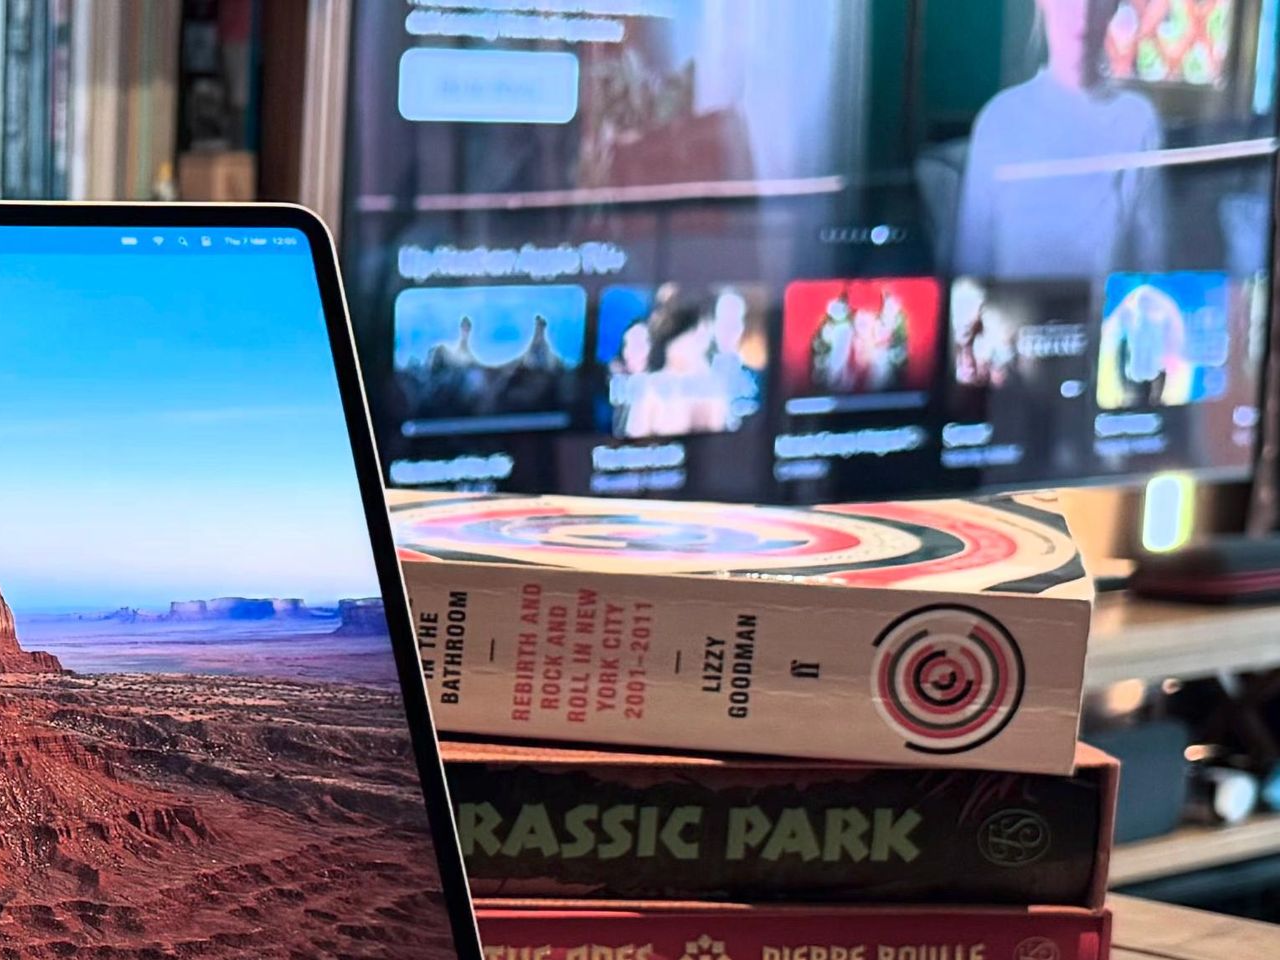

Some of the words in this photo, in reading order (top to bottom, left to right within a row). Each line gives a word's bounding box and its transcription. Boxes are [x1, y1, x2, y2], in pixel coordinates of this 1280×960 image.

[521, 583, 541, 625] AND
[546, 605, 568, 647] AND
[576, 588, 597, 634] NEW
[603, 603, 624, 649] CITY
[418, 612, 438, 650] THE
[440, 591, 468, 704] BATHROOM
[572, 643, 592, 664] IN
[511, 632, 537, 721] REBIRTH
[540, 655, 563, 710] ROCK
[596, 659, 619, 712] YORK
[702, 636, 726, 693] LIZZY
[728, 614, 757, 719] GOODMAN
[567, 673, 590, 722] ROLL
[725, 803, 923, 864] PARK
